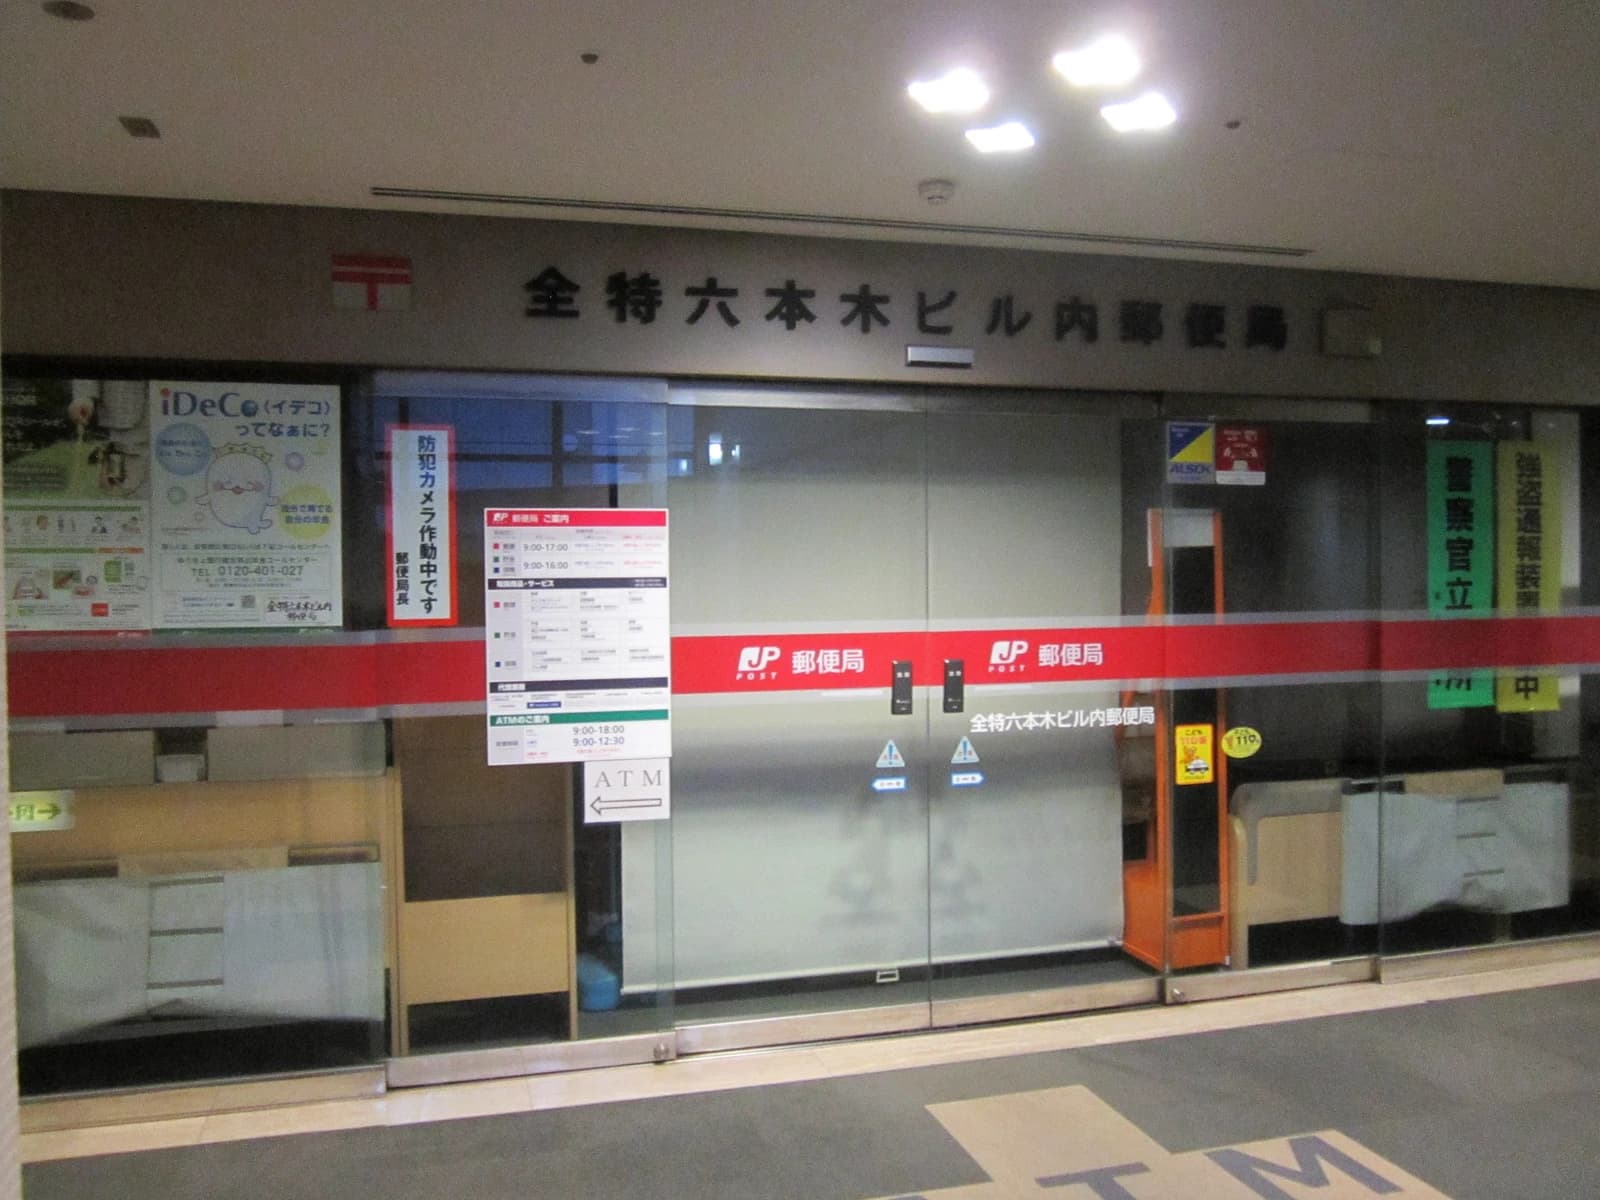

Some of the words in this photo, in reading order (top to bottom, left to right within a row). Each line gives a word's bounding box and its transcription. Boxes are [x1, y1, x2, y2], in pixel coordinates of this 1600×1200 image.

[523, 265, 1288, 350] 全特六本木ビル内郵便局
[418, 435, 438, 614] 防犯カメラ作動中です
[523, 543, 569, 552] 9:00-17:00
[217, 565, 304, 576] 0120-401-027
[395, 552, 409, 606] 郵便局長
[792, 649, 865, 674] 郵便局
[1038, 643, 1104, 667] 郵便局
[736, 671, 778, 681] POST
[988, 664, 1025, 673] POST
[969, 706, 1155, 733] 全特六本木ビル内郵便局
[572, 725, 625, 735] 9:00-18:00
[572, 736, 625, 747] 9:00-12:30
[594, 769, 663, 789] ATM
